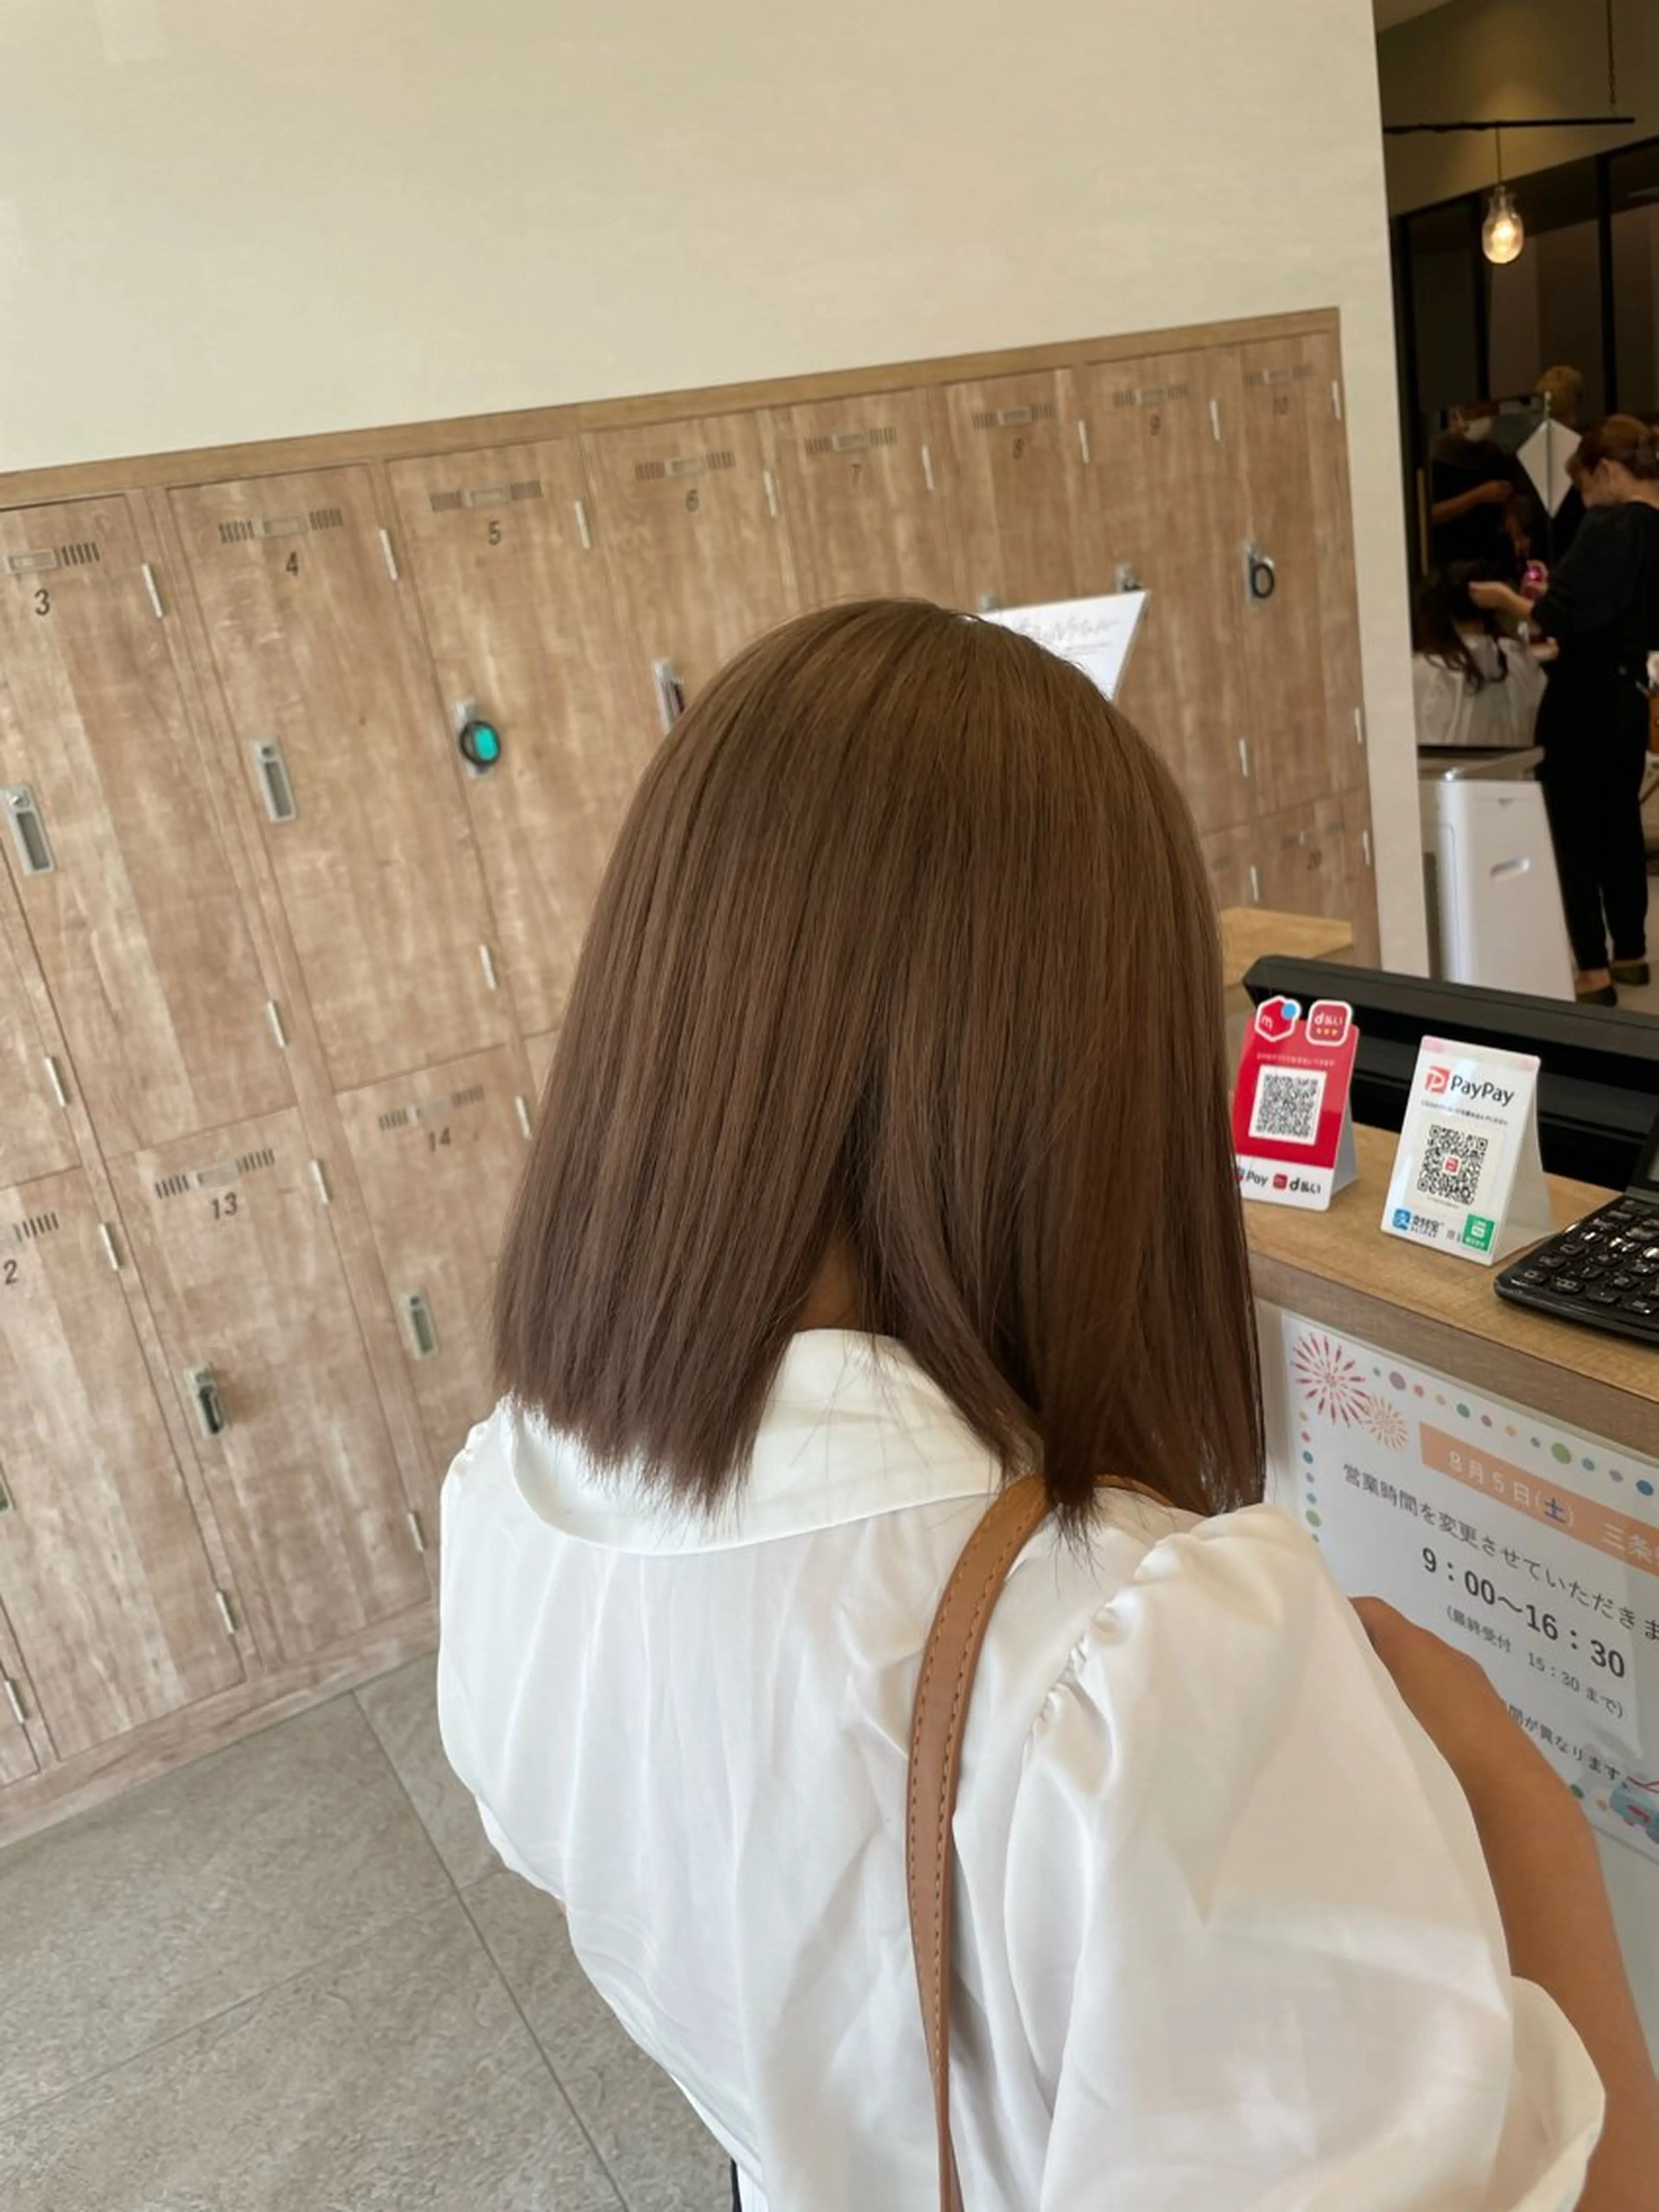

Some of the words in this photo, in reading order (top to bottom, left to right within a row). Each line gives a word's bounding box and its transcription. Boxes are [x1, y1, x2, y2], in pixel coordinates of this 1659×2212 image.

[851, 463, 862, 486] 7
[685, 489, 699, 512] 6
[488, 520, 502, 546] 5
[285, 551, 300, 577] 4
[34, 588, 50, 616] 3
[1450, 1074, 1515, 1107] PayPay
[426, 1125, 452, 1154] 14
[211, 1191, 238, 1220] 13
[3, 1259, 19, 1286] 2
